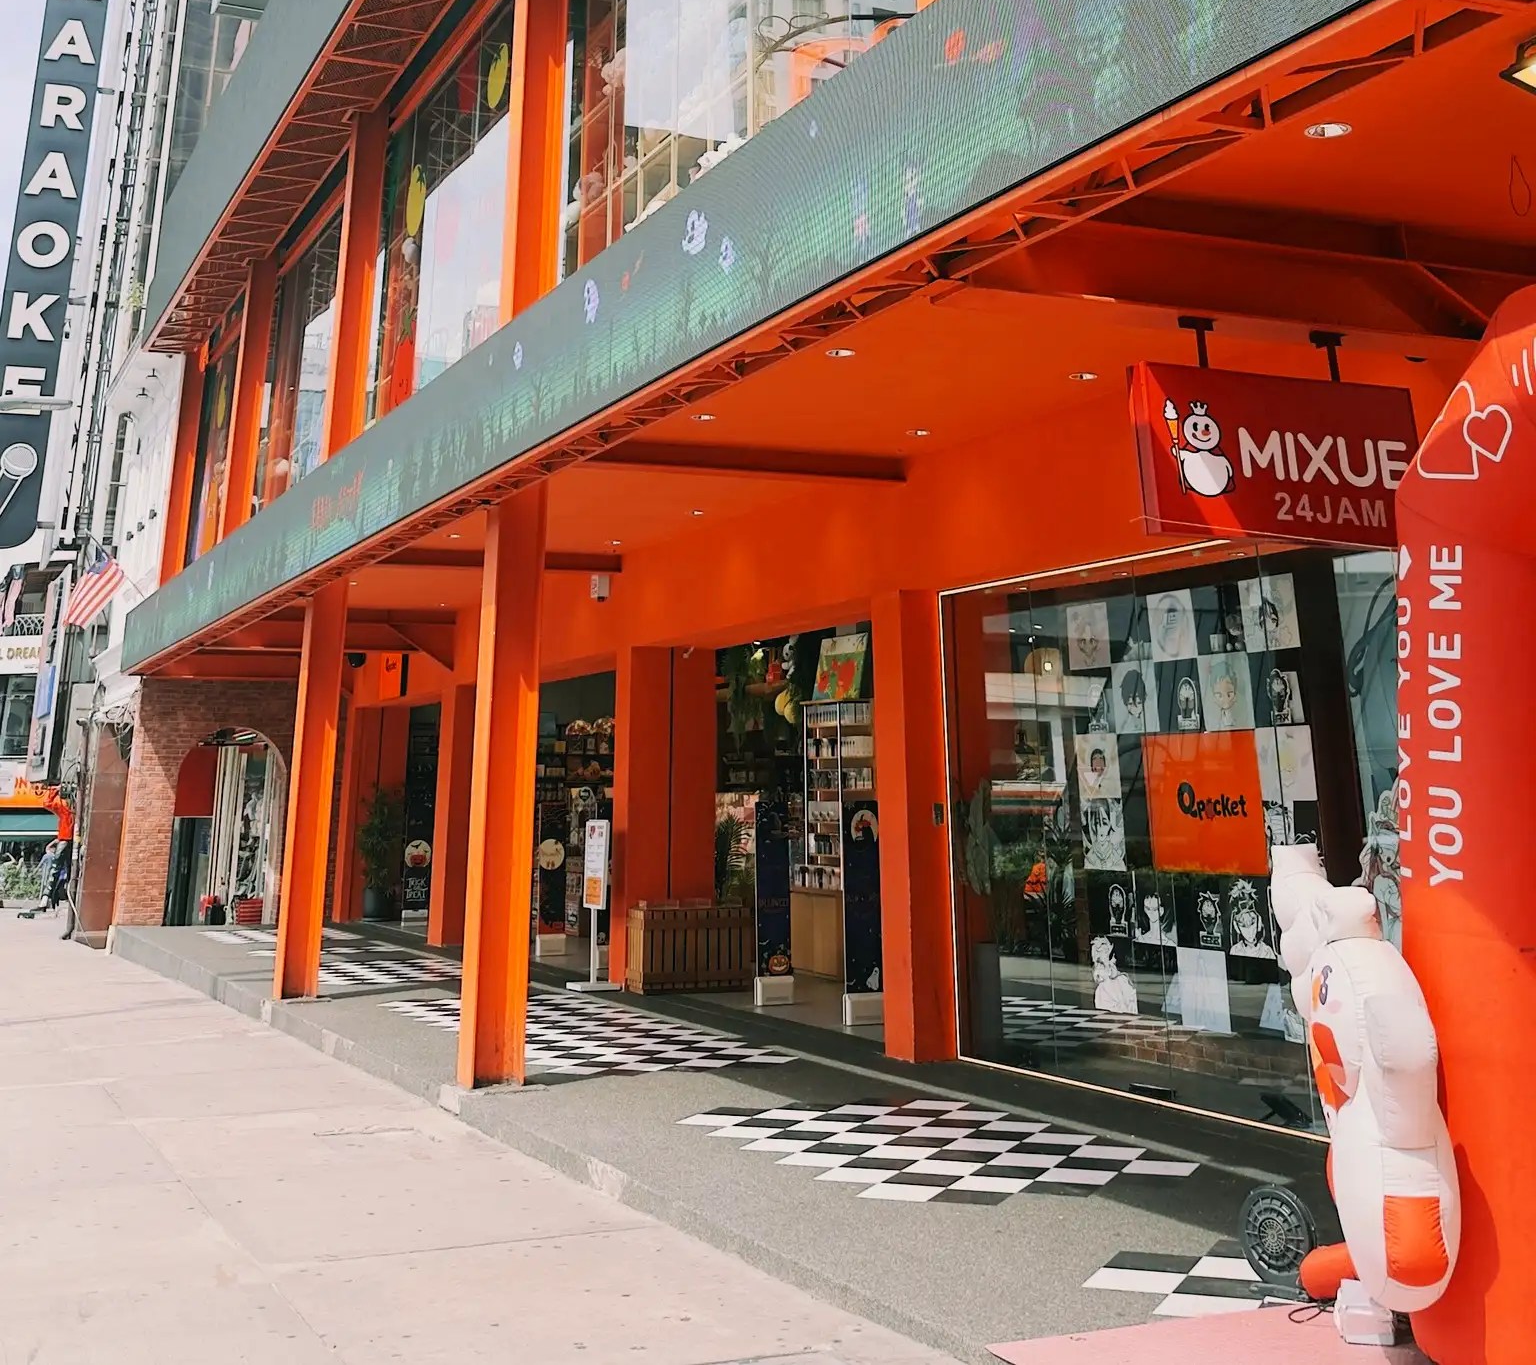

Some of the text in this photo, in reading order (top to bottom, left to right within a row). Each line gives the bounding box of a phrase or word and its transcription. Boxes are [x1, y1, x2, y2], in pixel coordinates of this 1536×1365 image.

[1238, 427, 1408, 490] MIXUE
[1427, 544, 1463, 887] YOU LOVE ME
